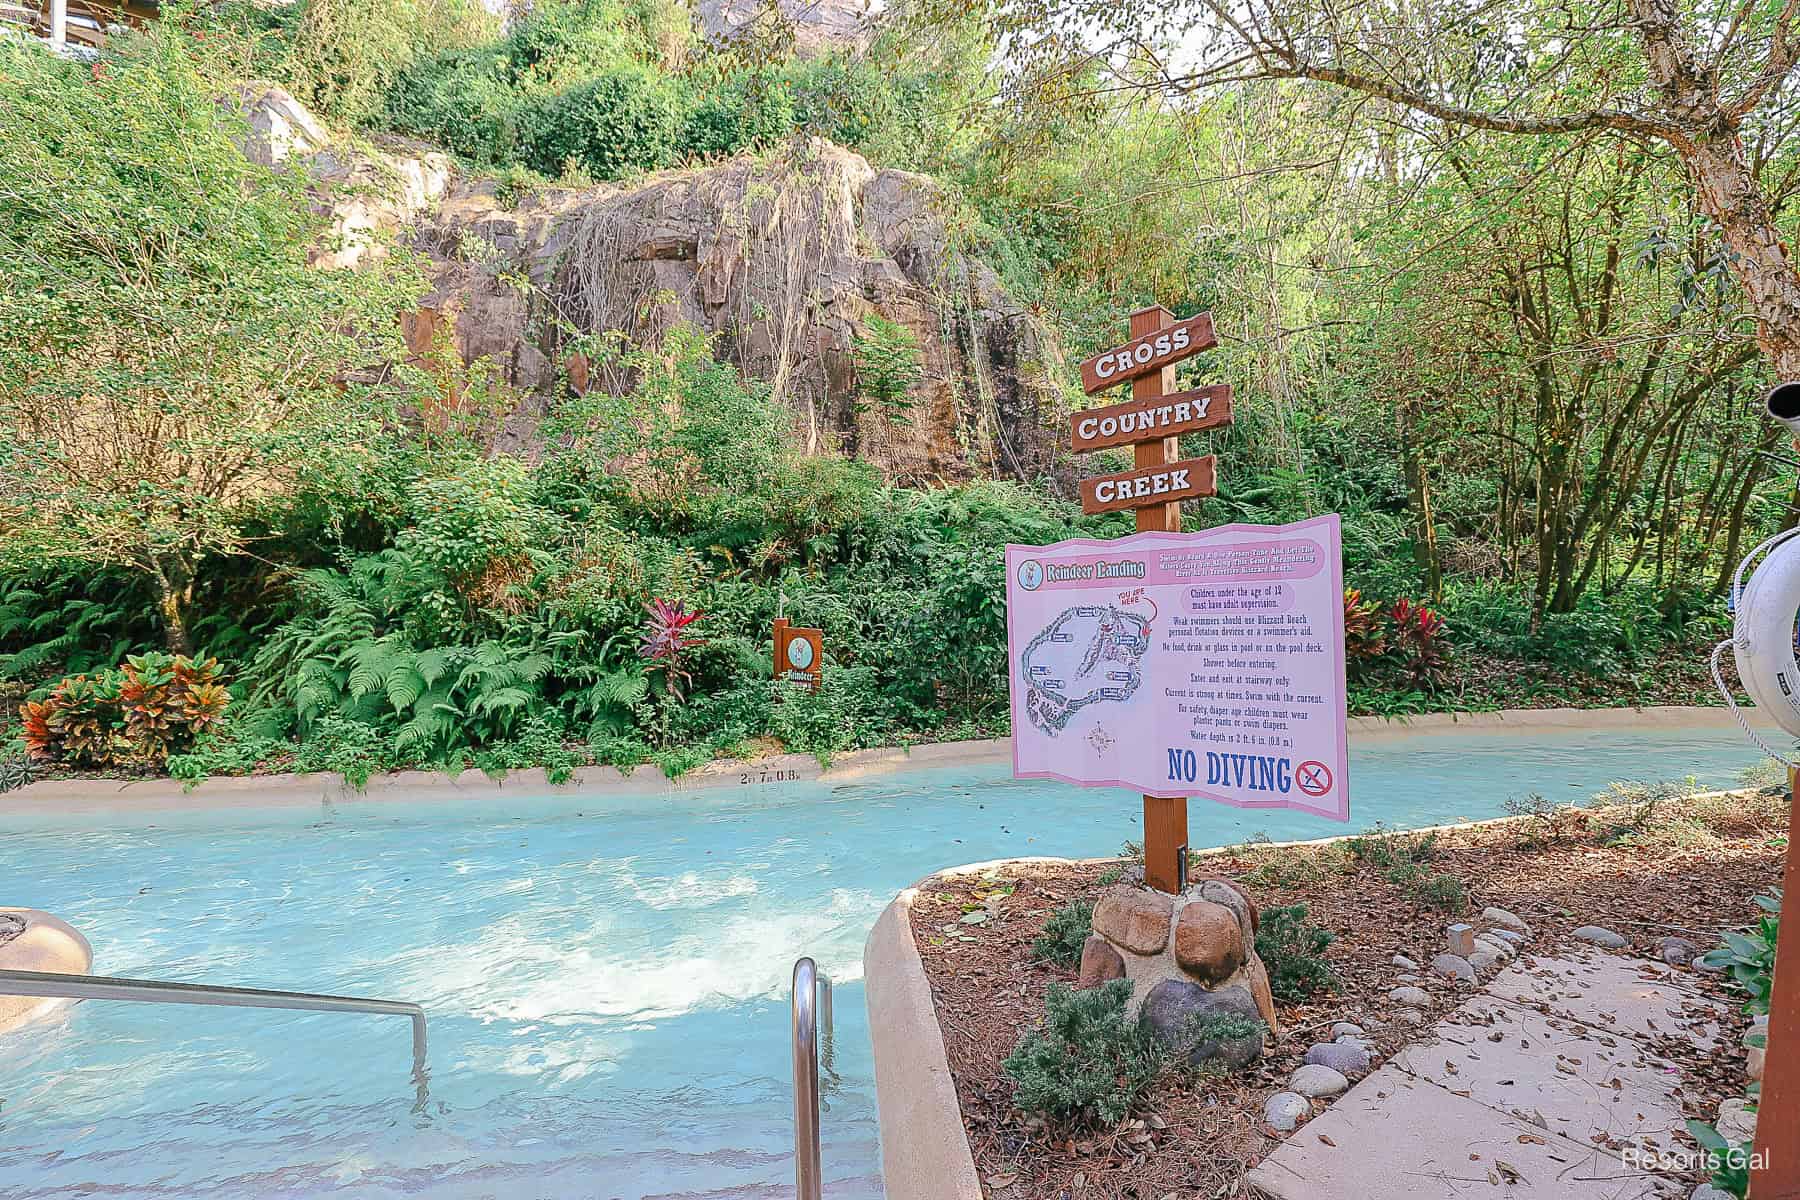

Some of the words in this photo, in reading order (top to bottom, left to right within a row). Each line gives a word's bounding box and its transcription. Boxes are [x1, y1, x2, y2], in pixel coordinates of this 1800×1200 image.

[1095, 327, 1190, 378] CROSS
[1078, 397, 1211, 440] COUNTRY
[1095, 469, 1190, 503] CREEK
[1047, 564, 1094, 582] Reindeer
[1096, 560, 1145, 579] Landing
[1190, 588, 1215, 598] Children
[1218, 587, 1235, 597] under
[1237, 586, 1248, 596] the
[1251, 588, 1262, 599] age
[1265, 586, 1271, 595] of
[1275, 585, 1282, 595] 12
[1192, 601, 1206, 610] must
[1208, 600, 1221, 609] have
[1224, 599, 1239, 609] adult
[1173, 616, 1187, 625] Weak
[1191, 616, 1219, 625] swimmers
[1223, 616, 1242, 625] should
[1258, 615, 1284, 625] Blizzard
[1287, 614, 1307, 624] Beach
[1222, 627, 1244, 636] devices
[1264, 626, 1297, 636] swimmer's
[1187, 642, 1201, 651] drink
[1214, 642, 1229, 653] glass
[1240, 642, 1253, 653] pool
[1276, 642, 1286, 652] the
[1289, 642, 1303, 654] pool
[1203, 658, 1224, 667] Shower
[1227, 658, 1246, 667] before
[1209, 674, 1219, 682] and
[1222, 673, 1233, 683] exit
[1245, 674, 1273, 687] stairway
[1165, 688, 1186, 697] Current
[1217, 690, 1223, 698] at
[1245, 691, 1263, 700] Swim
[1266, 691, 1280, 701] with
[1283, 692, 1293, 701] the
[1297, 695, 1324, 703] current.
[1178, 704, 1187, 713] For
[1231, 708, 1241, 717] age
[1244, 707, 1270, 717] children
[1272, 710, 1288, 718] must
[1291, 712, 1308, 720] wear
[1243, 720, 1260, 728] swim
[1190, 730, 1207, 740] Water
[1210, 732, 1225, 743] depth
[1228, 734, 1234, 743] is
[1236, 734, 1241, 743] 2
[1167, 748, 1197, 782] NO
[1206, 751, 1291, 794] DIVING
